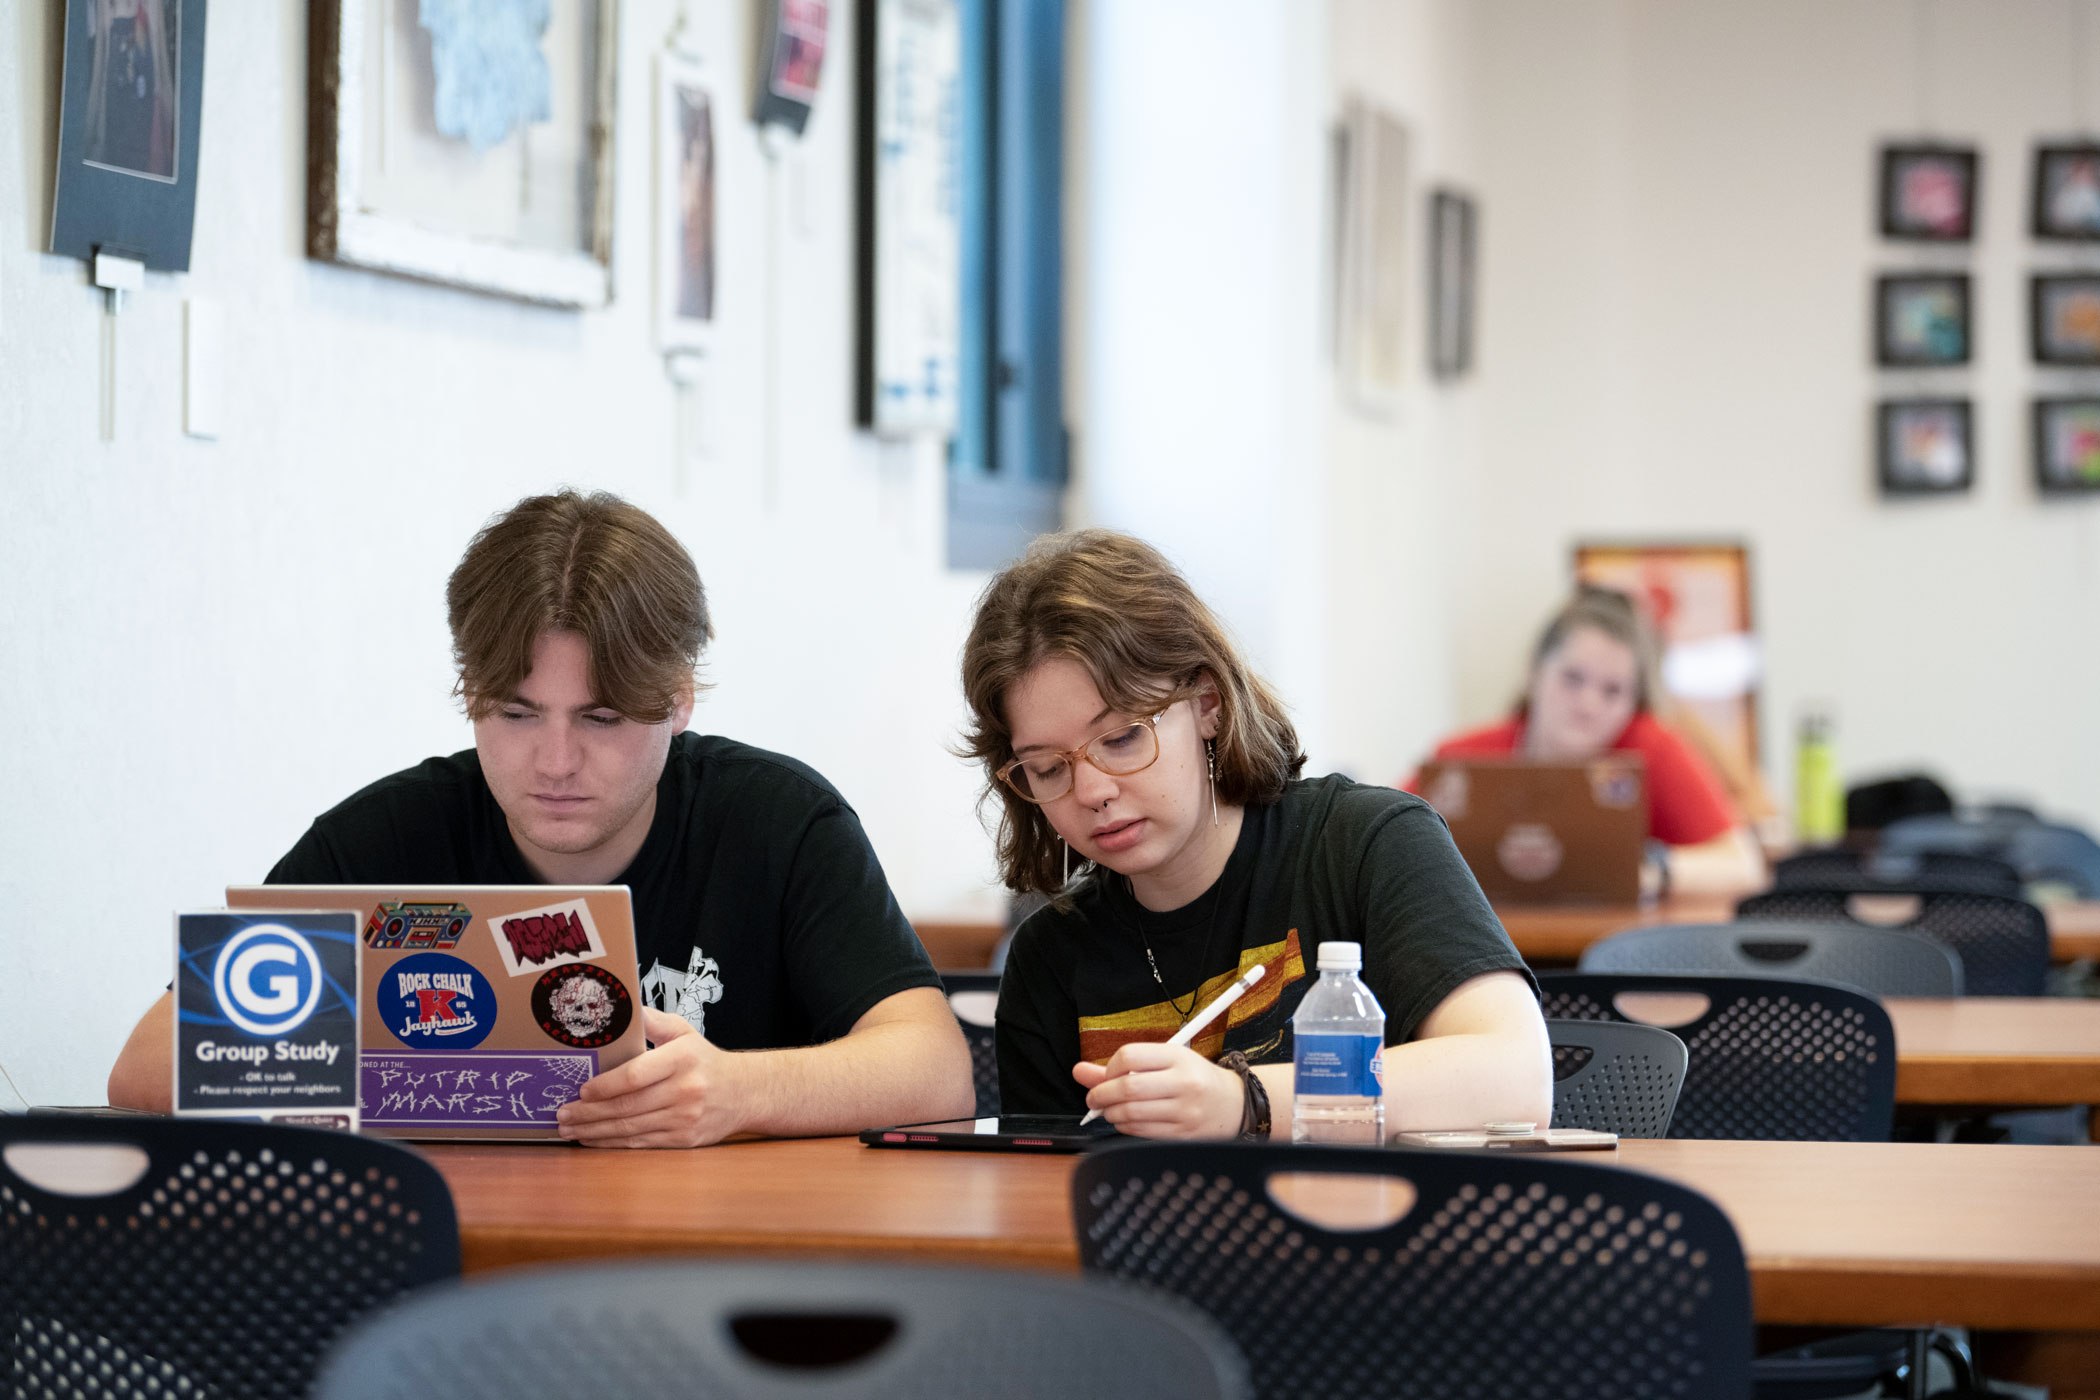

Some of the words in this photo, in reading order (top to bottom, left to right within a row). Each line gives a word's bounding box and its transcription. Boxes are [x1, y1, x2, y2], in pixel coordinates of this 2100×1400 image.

[398, 973, 431, 999] ROCK
[433, 973, 474, 1000] CHALK
[399, 1010, 476, 1037] Jayhawk
[196, 1040, 269, 1067] Group
[274, 1040, 339, 1065] Study
[380, 1061, 390, 1069] AT
[200, 1085, 231, 1095] Please
[232, 1086, 268, 1096] respect
[270, 1086, 291, 1096] your
[293, 1085, 342, 1096] neighbors
[245, 1072, 262, 1082] OK
[264, 1073, 275, 1082] to
[277, 1072, 296, 1082] talk
[375, 1090, 535, 1120] MARSH
